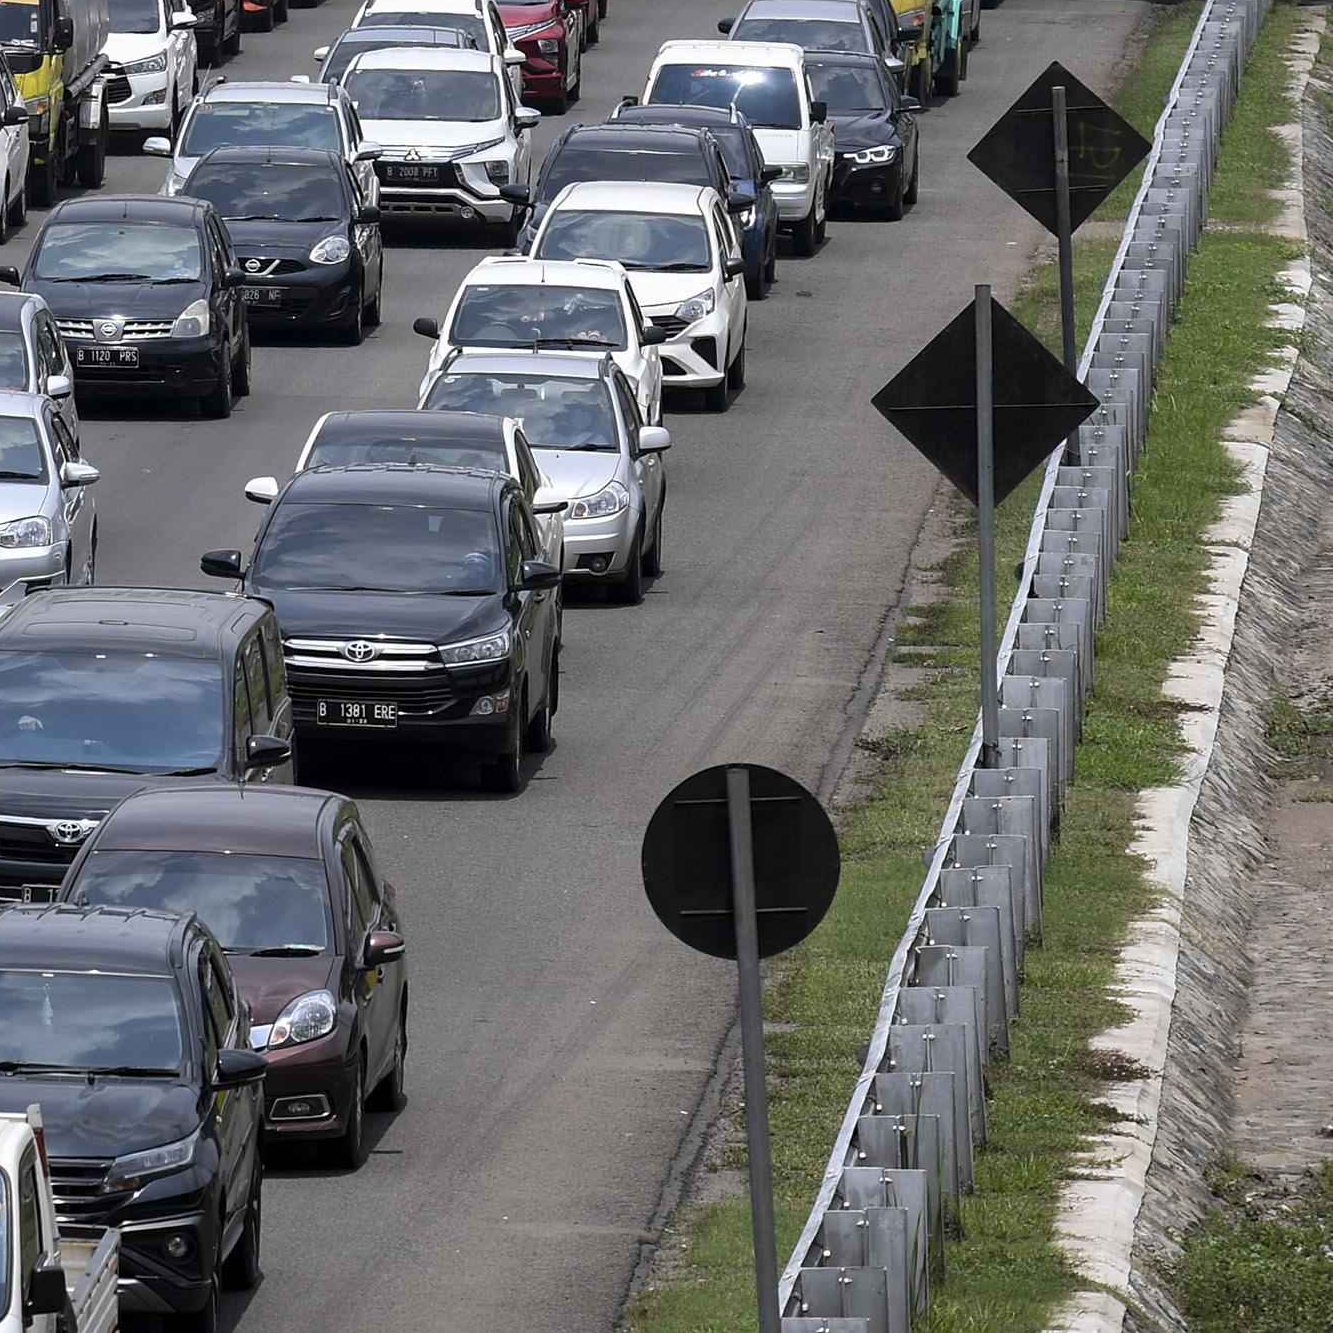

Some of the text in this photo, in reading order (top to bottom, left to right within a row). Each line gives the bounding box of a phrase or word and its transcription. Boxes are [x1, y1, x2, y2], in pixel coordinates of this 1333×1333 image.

[388, 167, 392, 175] B
[400, 167, 418, 176] 2008
[78, 350, 137, 361] B 1120 PRS
[320, 703, 395, 719] B 1381 ERE
[24, 888, 31, 903] B
